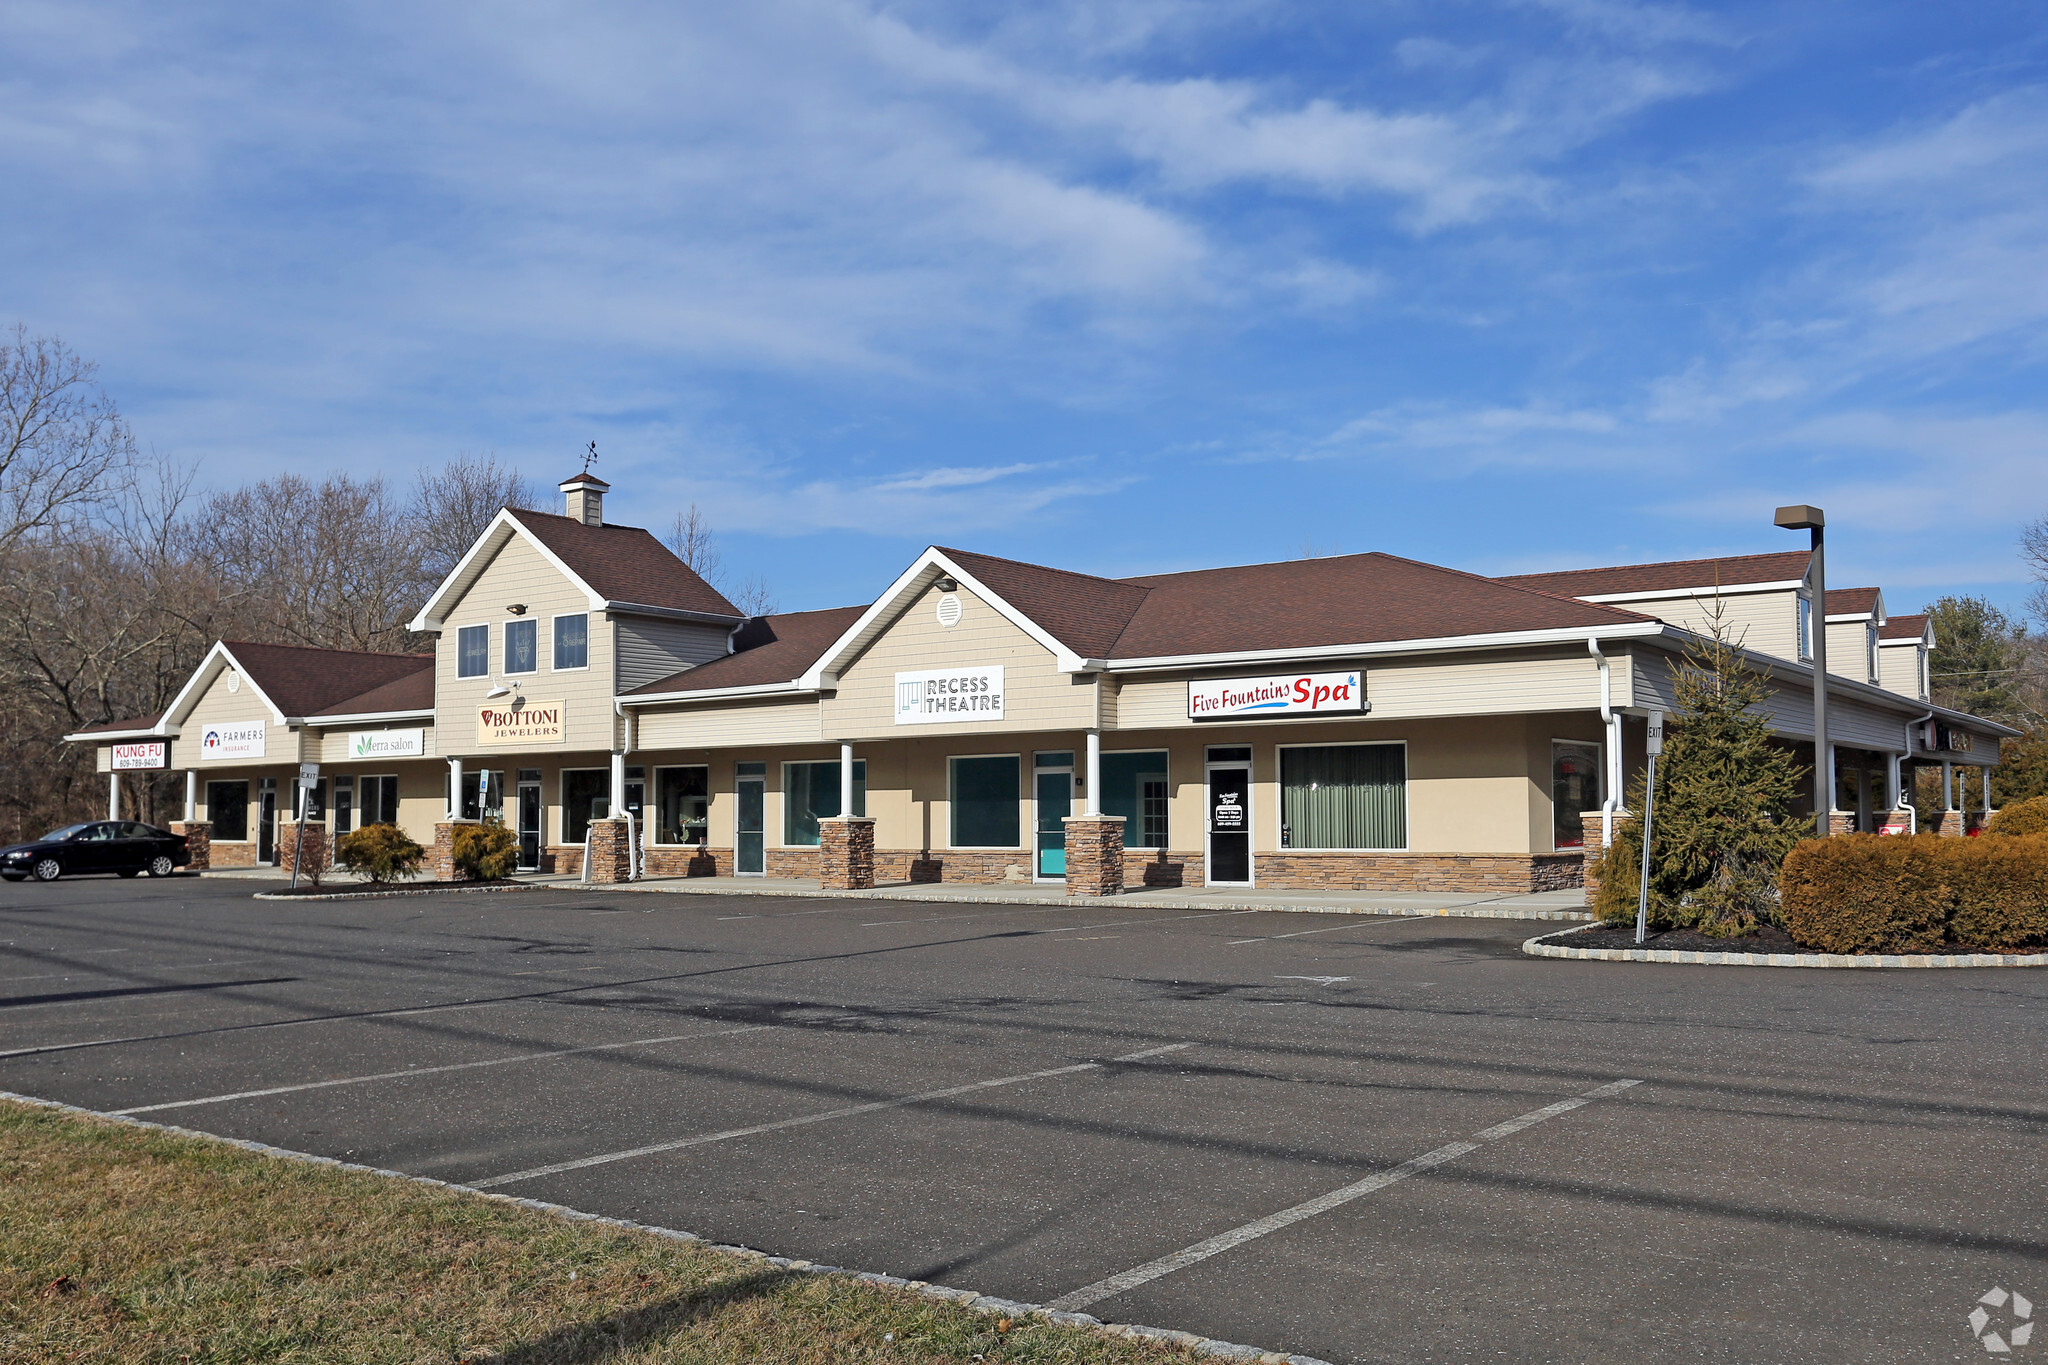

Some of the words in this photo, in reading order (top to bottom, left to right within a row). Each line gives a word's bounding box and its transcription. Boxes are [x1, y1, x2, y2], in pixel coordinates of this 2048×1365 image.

[927, 676, 989, 695] RECESS
[1192, 694, 1219, 714] Five
[1222, 681, 1290, 708] Fountains
[1292, 678, 1350, 709] Spa
[926, 694, 1001, 713] THEATRE
[493, 709, 558, 727] BOTTONI
[223, 730, 263, 741] FARMERS
[494, 727, 559, 738] JEWELERS
[1649, 727, 1661, 738] EXIT
[115, 745, 146, 758] KUNG
[148, 744, 163, 757] FU
[390, 737, 414, 751] salon
[119, 758, 158, 768] 609-789-9400
[301, 771, 317, 780] EXIT
